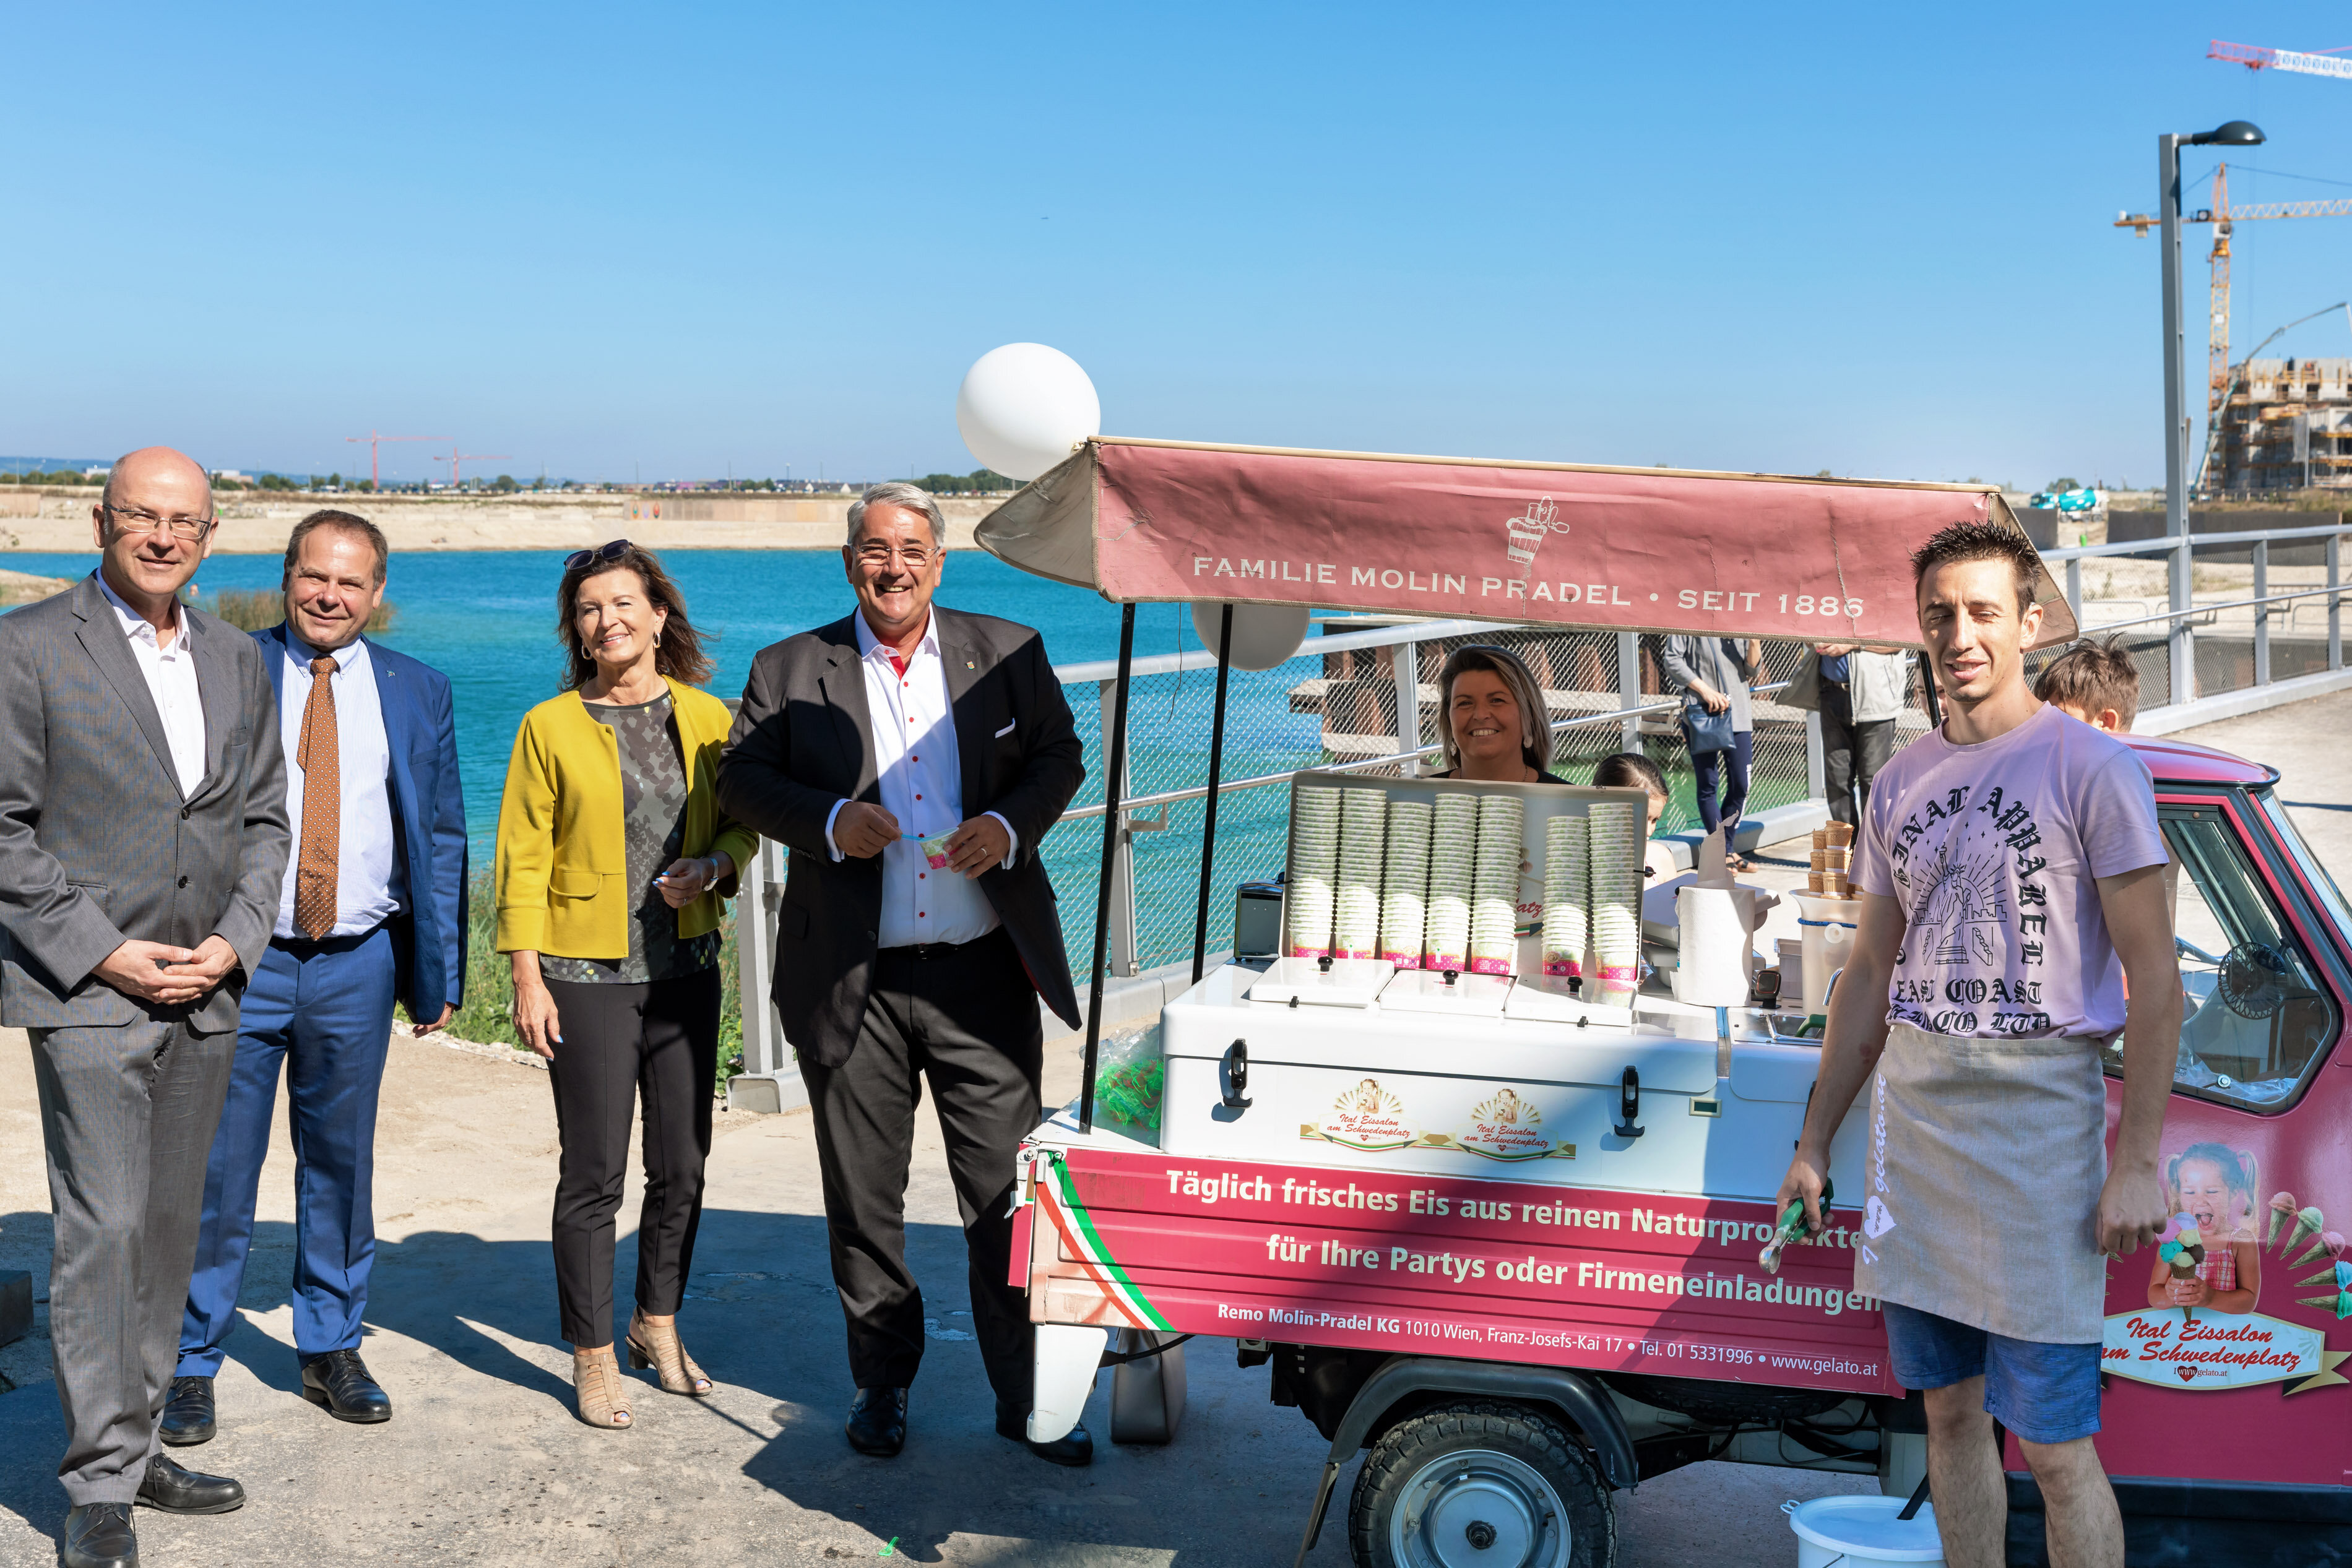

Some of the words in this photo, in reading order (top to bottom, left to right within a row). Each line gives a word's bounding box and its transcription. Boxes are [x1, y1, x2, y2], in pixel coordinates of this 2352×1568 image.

[1193, 556, 1337, 585] FAMILIE
[1351, 566, 1467, 595] MOLIN
[1481, 576, 1632, 607] PRADEL
[1676, 588, 1761, 612] SEIT
[1778, 593, 1864, 618] 1886
[1945, 978, 2042, 1006] COAST
[1339, 1114, 1358, 1124] Ital
[1360, 1115, 1399, 1126] Eissalon
[1344, 1124, 1411, 1139] Schwedenplatz
[1476, 1124, 1495, 1133] Ital
[1498, 1125, 1537, 1136] Eissalon
[1482, 1134, 1549, 1149] Schwedenplatz
[1166, 1170, 1272, 1204] Täglich
[1281, 1178, 1399, 1212] frisches
[1409, 1189, 1450, 1216] Eis
[1459, 1200, 1511, 1221] aus
[1522, 1200, 1620, 1230] reinen
[1266, 1234, 1312, 1263] für
[1321, 1239, 1380, 1269] Ihre
[1390, 1246, 1485, 1283] Partys
[1495, 1256, 1568, 1285] oder
[1578, 1262, 1882, 1316] Firmeneinladungen
[1218, 1304, 1263, 1321] Remo
[1268, 1308, 1372, 1331] Molin-Pradel
[1377, 1317, 1400, 1333] KG
[1406, 1320, 1440, 1337] 1010
[1443, 1324, 1482, 1343] Wien,
[1487, 1327, 1599, 1351] Franz-Josefs-Kai
[1606, 1337, 1622, 1352] 17
[1639, 1340, 1662, 1356] Tel.
[1667, 1343, 1683, 1358] 01
[1690, 1345, 1753, 1365] 5331996
[1771, 1356, 1878, 1377] www.gelato.at
[2126, 1317, 2172, 1338] Ital
[2179, 1319, 2273, 1343] Eissalon
[2138, 1341, 2301, 1372] Schwedenplatz
[2197, 1368, 2228, 1377] gelato.at
